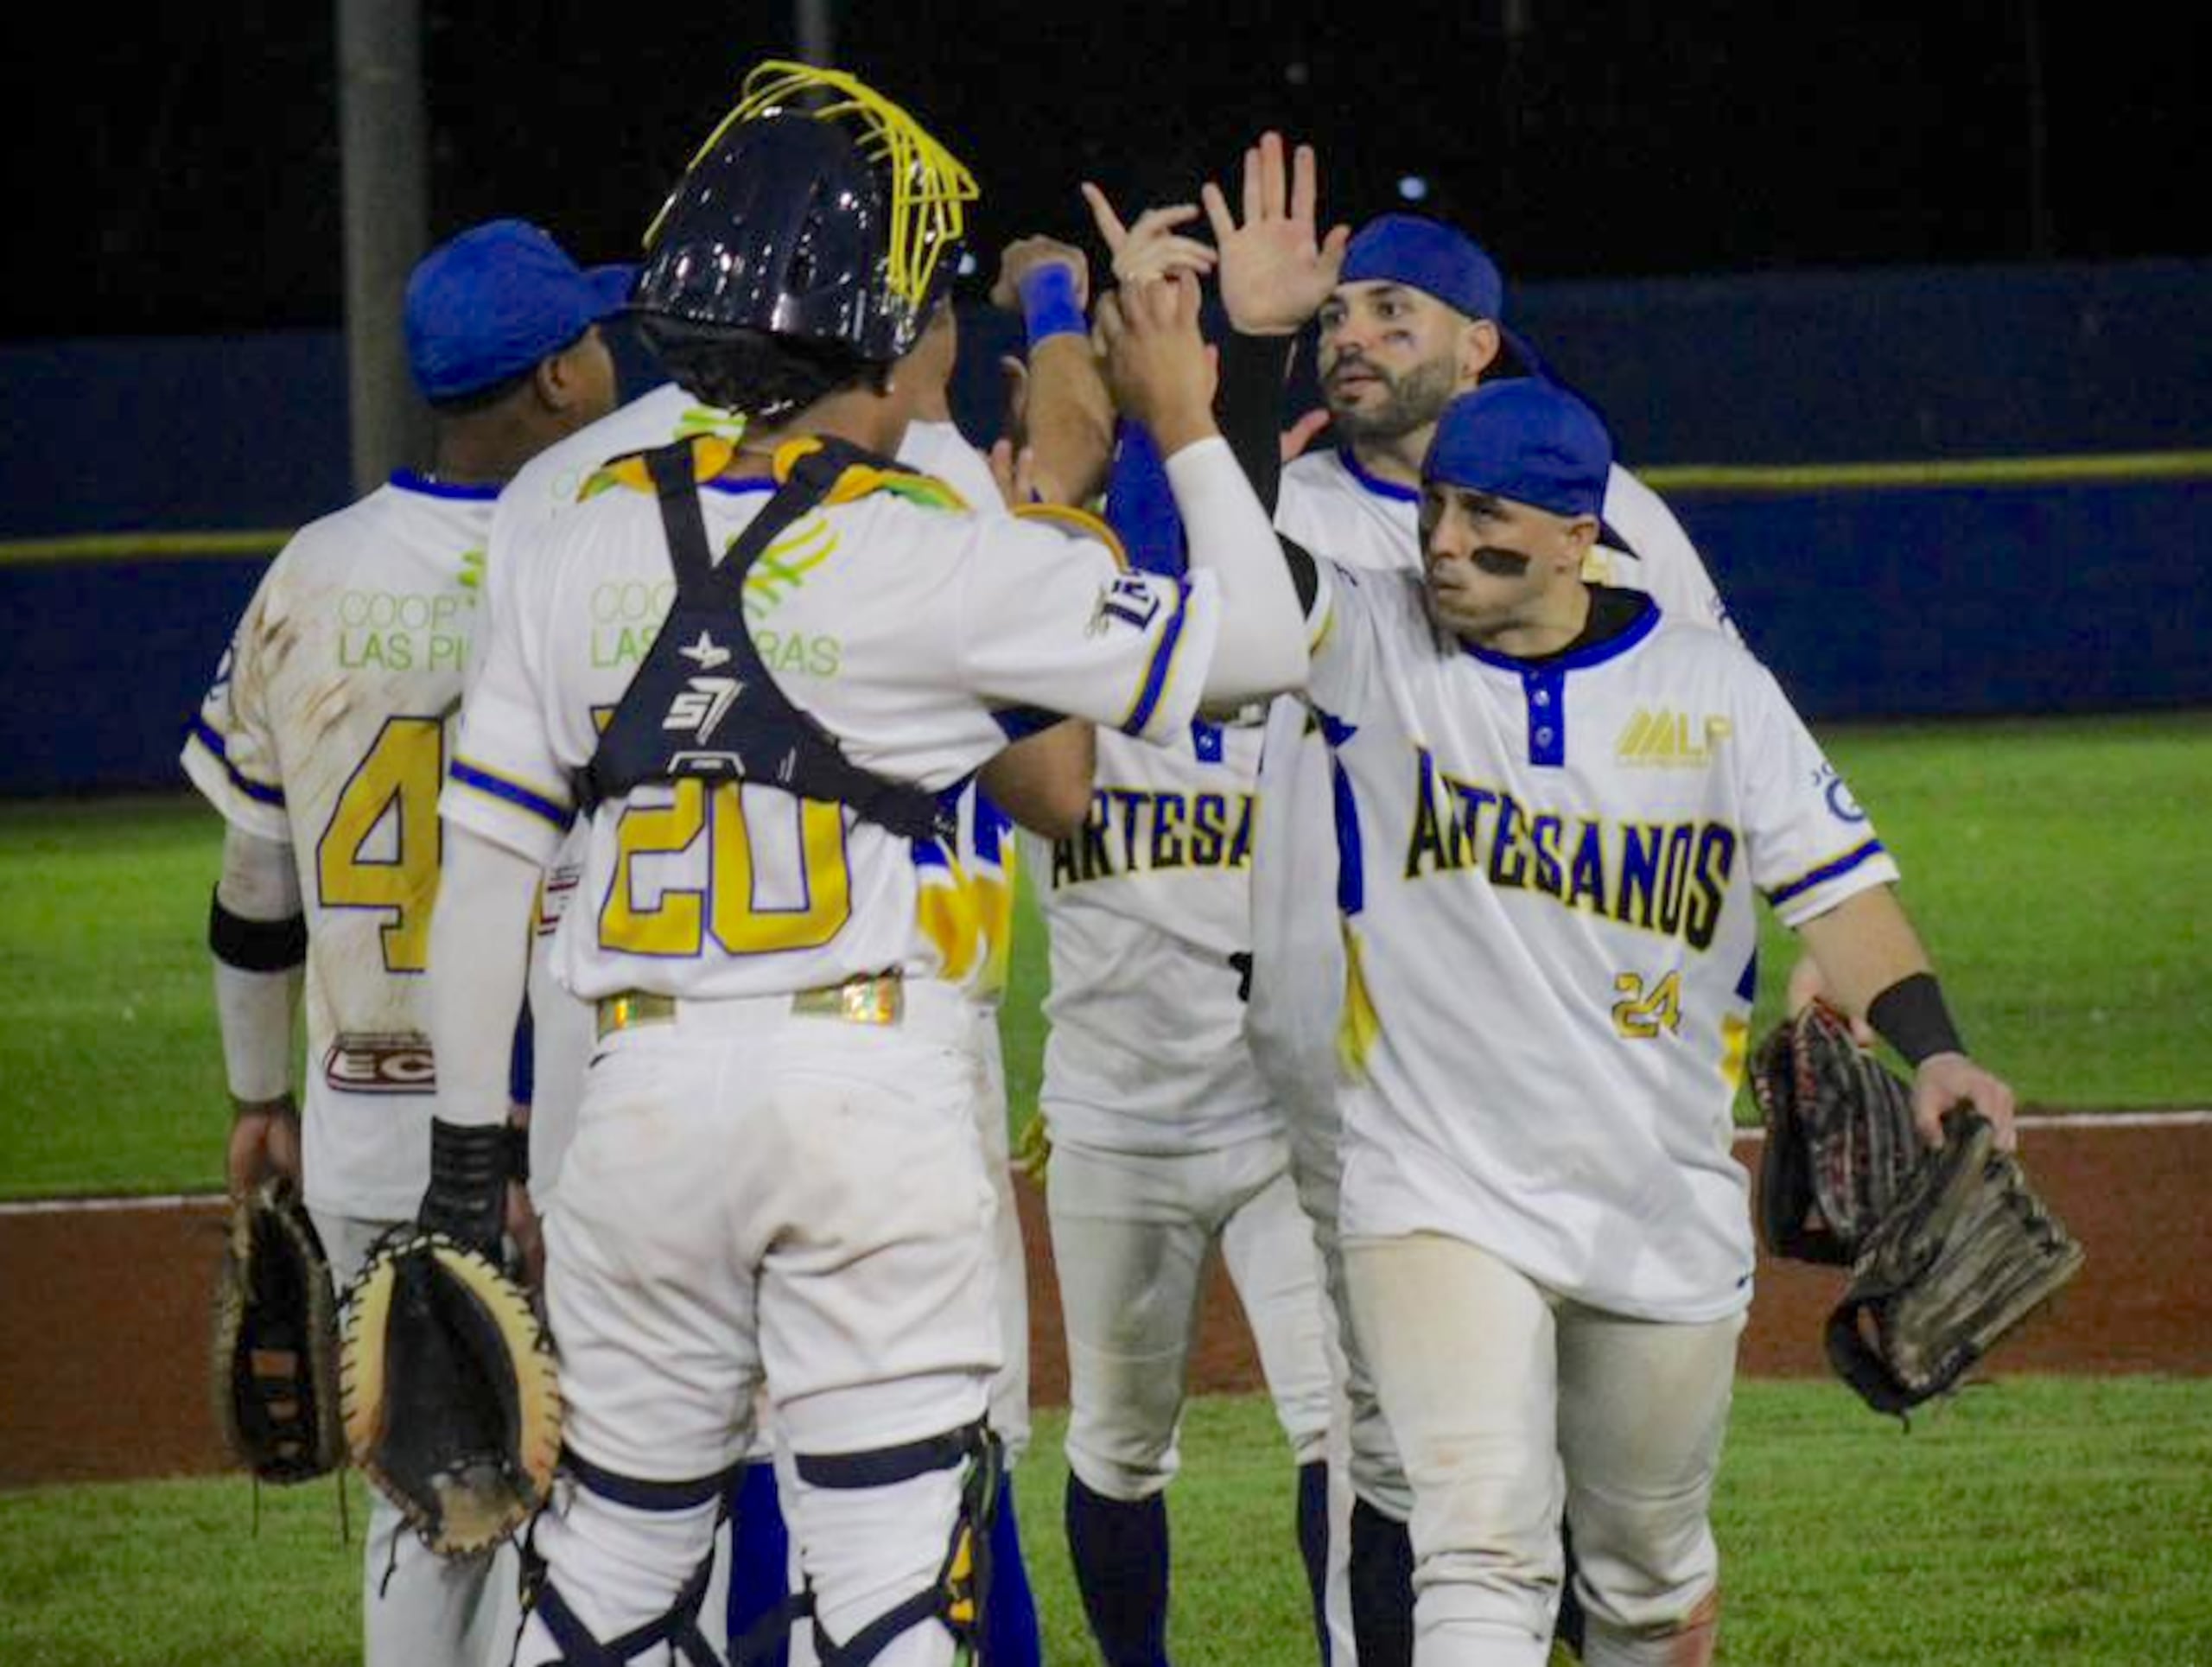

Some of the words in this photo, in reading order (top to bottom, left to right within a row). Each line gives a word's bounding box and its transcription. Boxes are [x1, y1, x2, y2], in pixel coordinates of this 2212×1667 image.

[338, 589, 458, 630] COOP
[339, 632, 413, 671] LAS
[598, 775, 853, 957] 20
[1611, 970, 1683, 1039] 24
